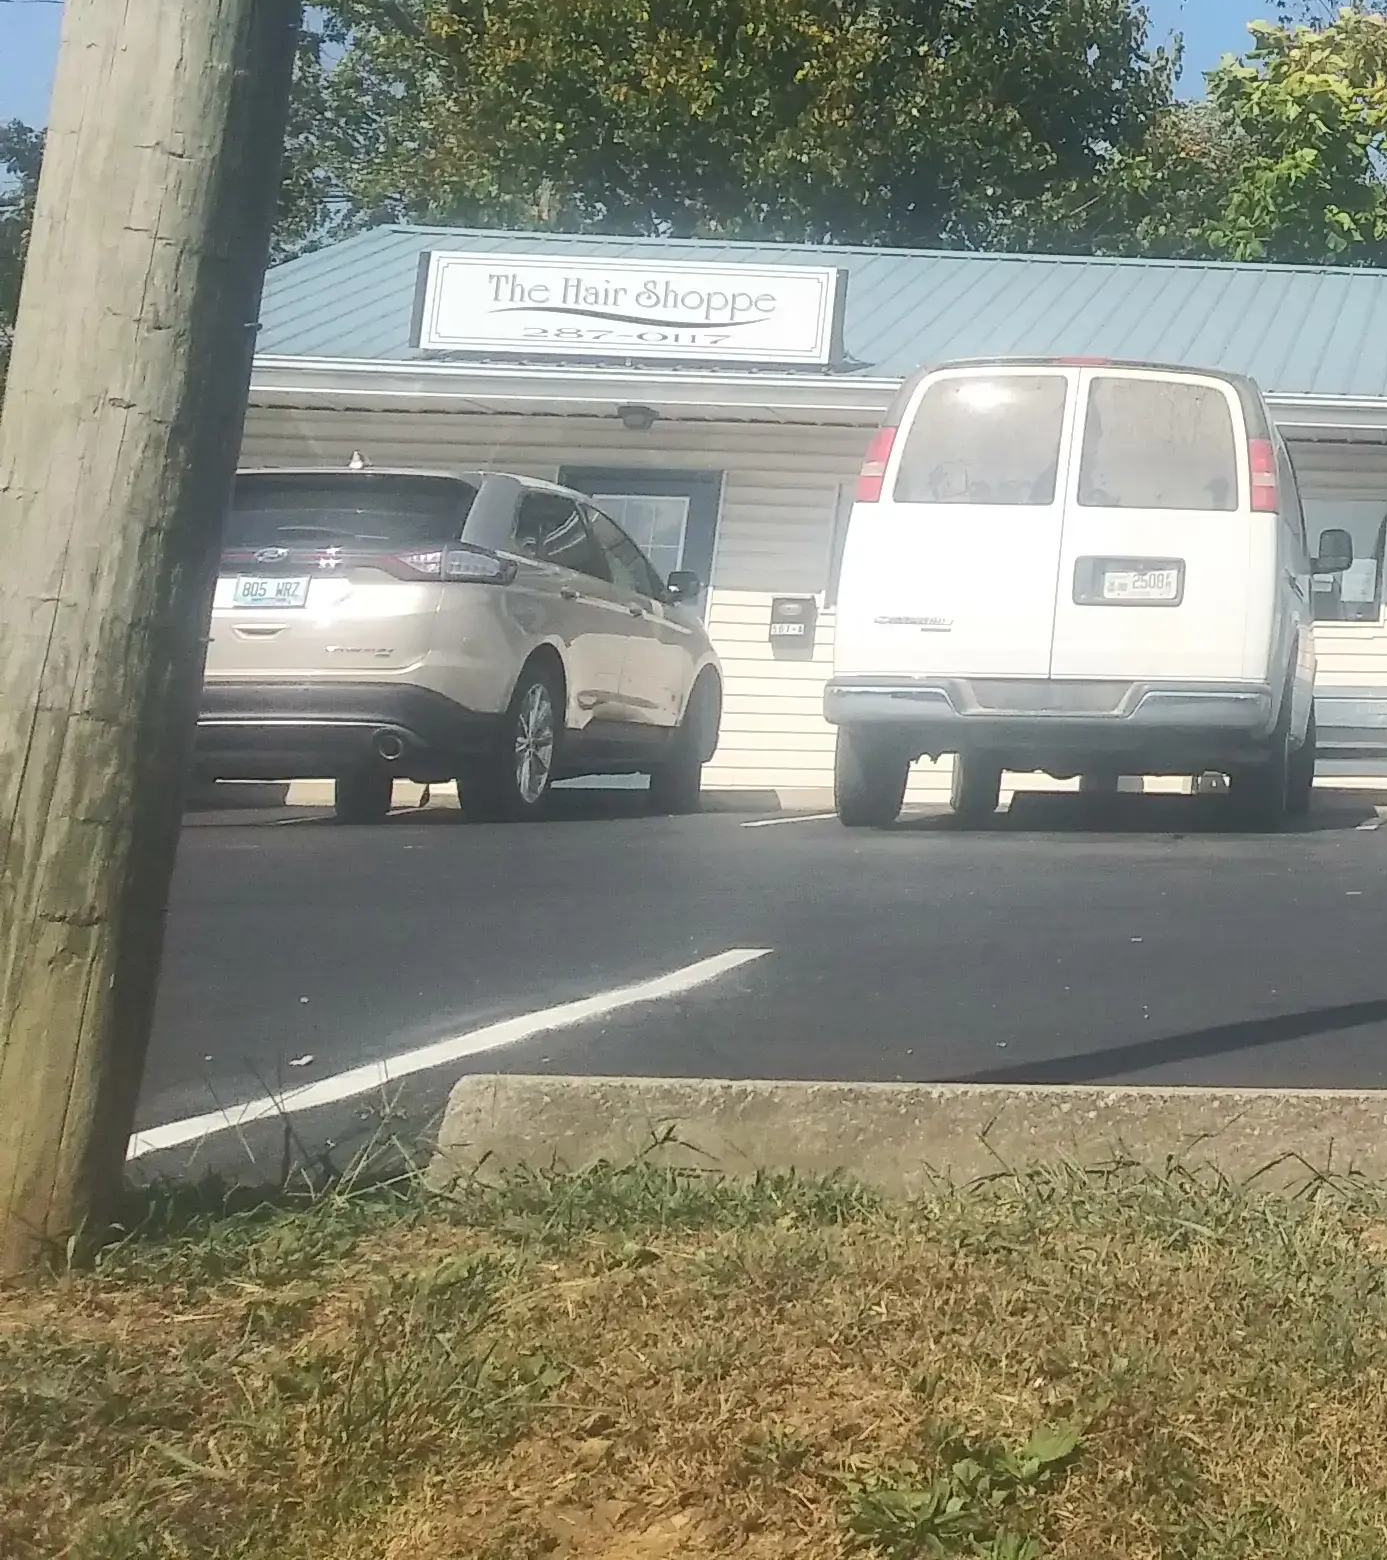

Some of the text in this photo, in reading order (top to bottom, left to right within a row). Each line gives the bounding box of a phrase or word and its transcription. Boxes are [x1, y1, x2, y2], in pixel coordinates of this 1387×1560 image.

[488, 273, 777, 321] The Hair Shoppe
[522, 327, 732, 345] 287-0117
[242, 581, 301, 597] 805 WRZ
